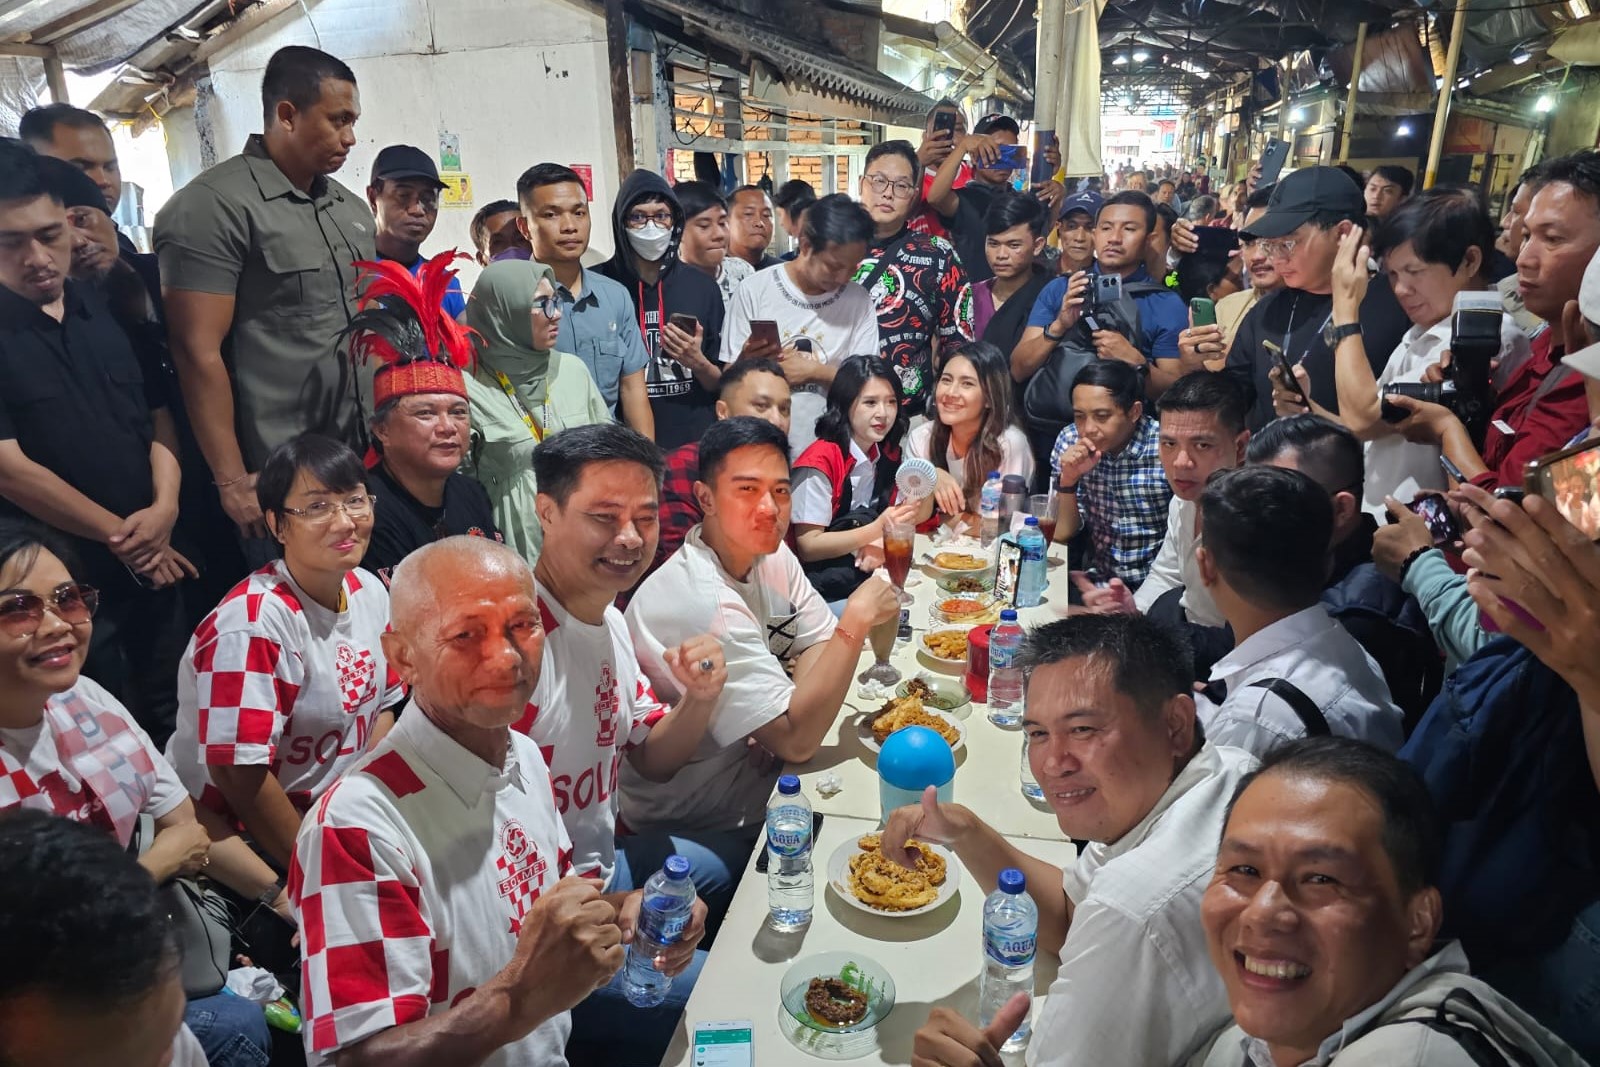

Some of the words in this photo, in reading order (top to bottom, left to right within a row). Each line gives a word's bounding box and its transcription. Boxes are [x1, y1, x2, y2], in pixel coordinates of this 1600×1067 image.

[669, 383, 691, 394] 1969
[772, 832, 801, 847] AQUA
[502, 860, 547, 893] SOLMET
[1003, 938, 1034, 954] AQUA
